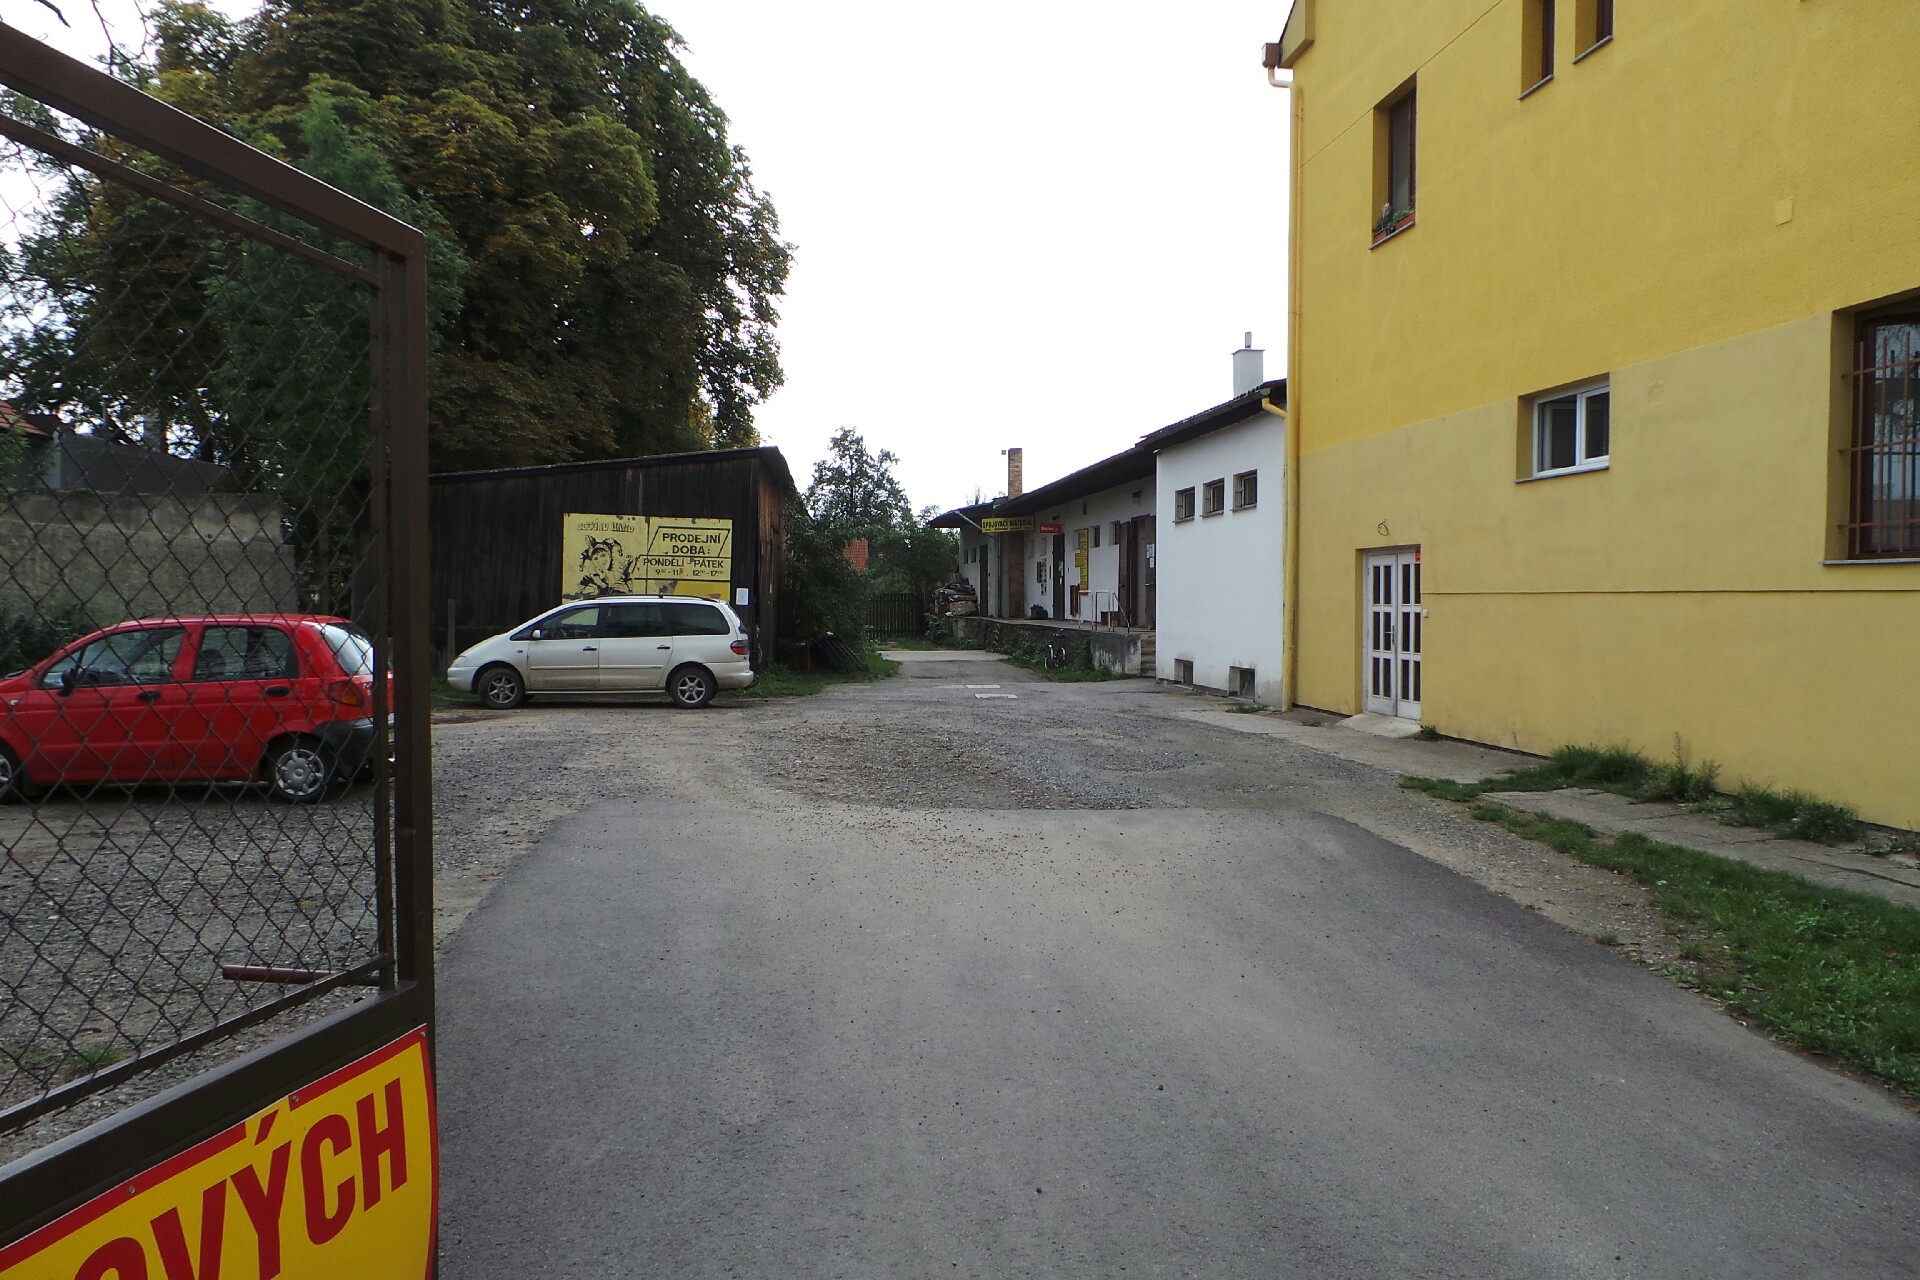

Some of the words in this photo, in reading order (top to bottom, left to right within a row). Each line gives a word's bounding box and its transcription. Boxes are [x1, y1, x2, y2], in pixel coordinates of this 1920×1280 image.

[662, 532, 721, 544] PRODEJNÍ
[693, 557, 724, 569] PÁTEK
[73, 1077, 408, 1280] VÝCH
